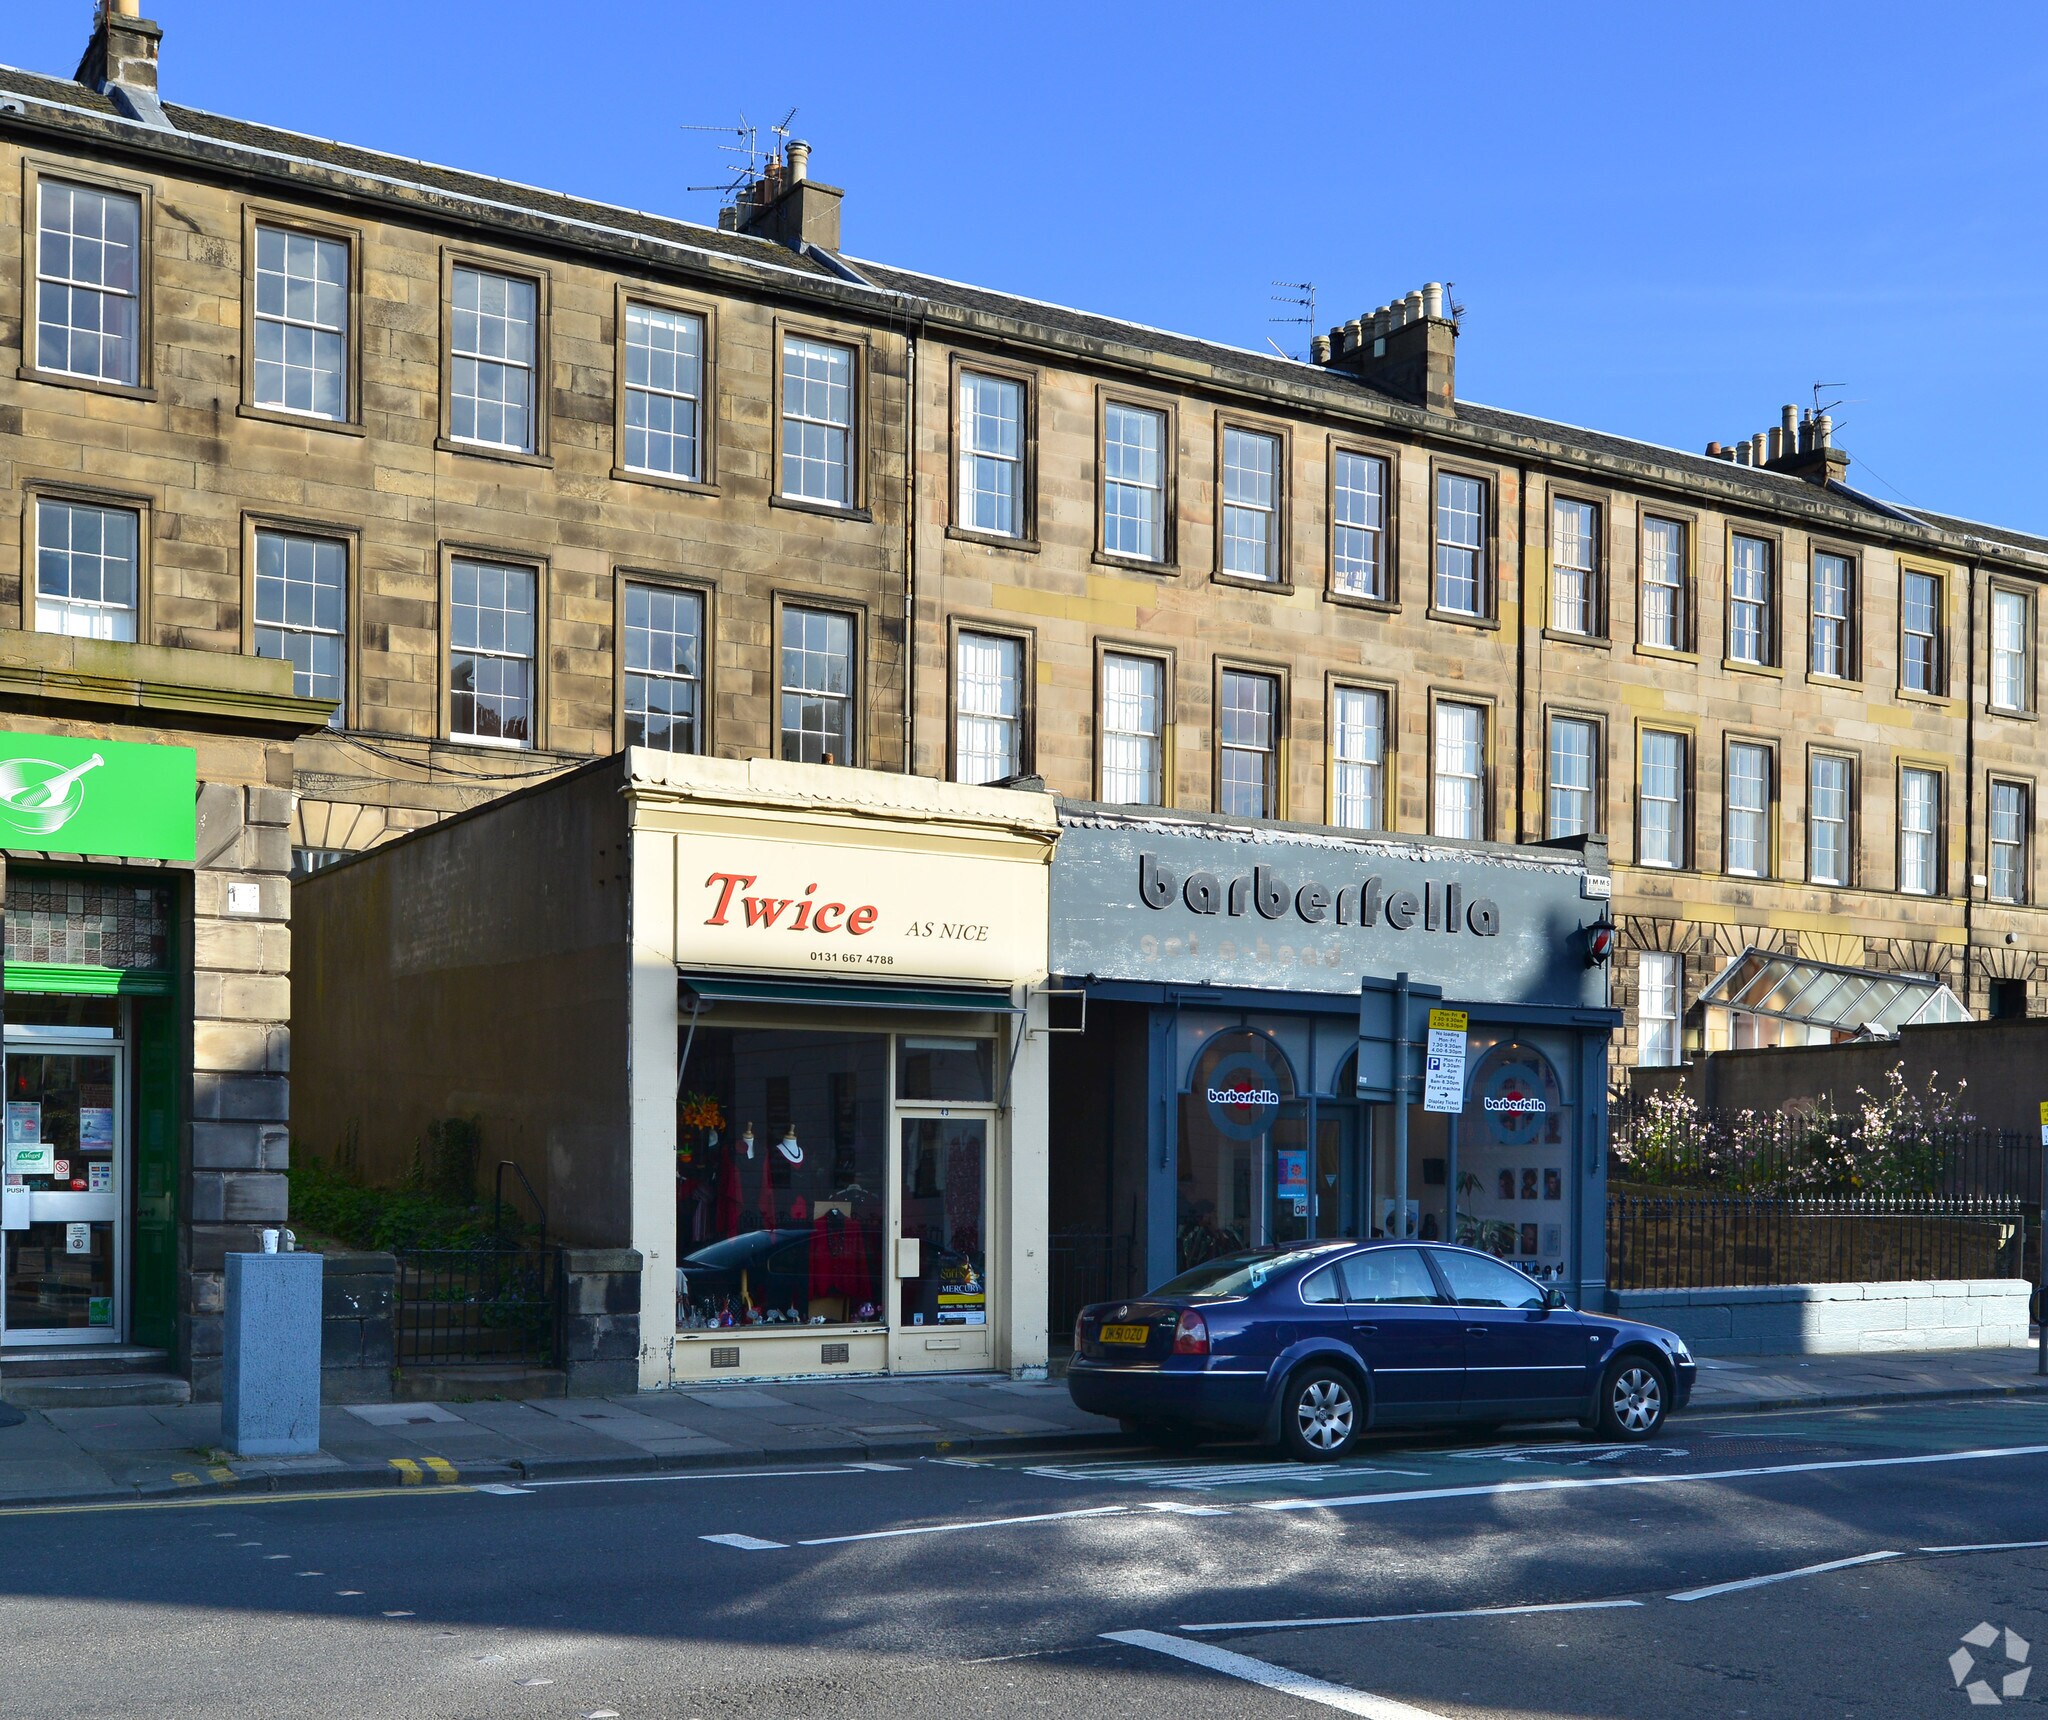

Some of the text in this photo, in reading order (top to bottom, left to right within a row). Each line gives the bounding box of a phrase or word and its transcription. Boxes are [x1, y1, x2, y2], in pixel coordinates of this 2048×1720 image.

[1138, 850, 1500, 937] barberfella
[703, 871, 878, 936] Twice
[905, 921, 989, 942] AS NICE
[810, 951, 894, 966] 0131 667 4788
[1430, 1058, 1439, 1070] P
[1207, 1088, 1279, 1105] barberfella
[1484, 1096, 1546, 1112] barberfella
[941, 1285, 981, 1293] MERCURY
